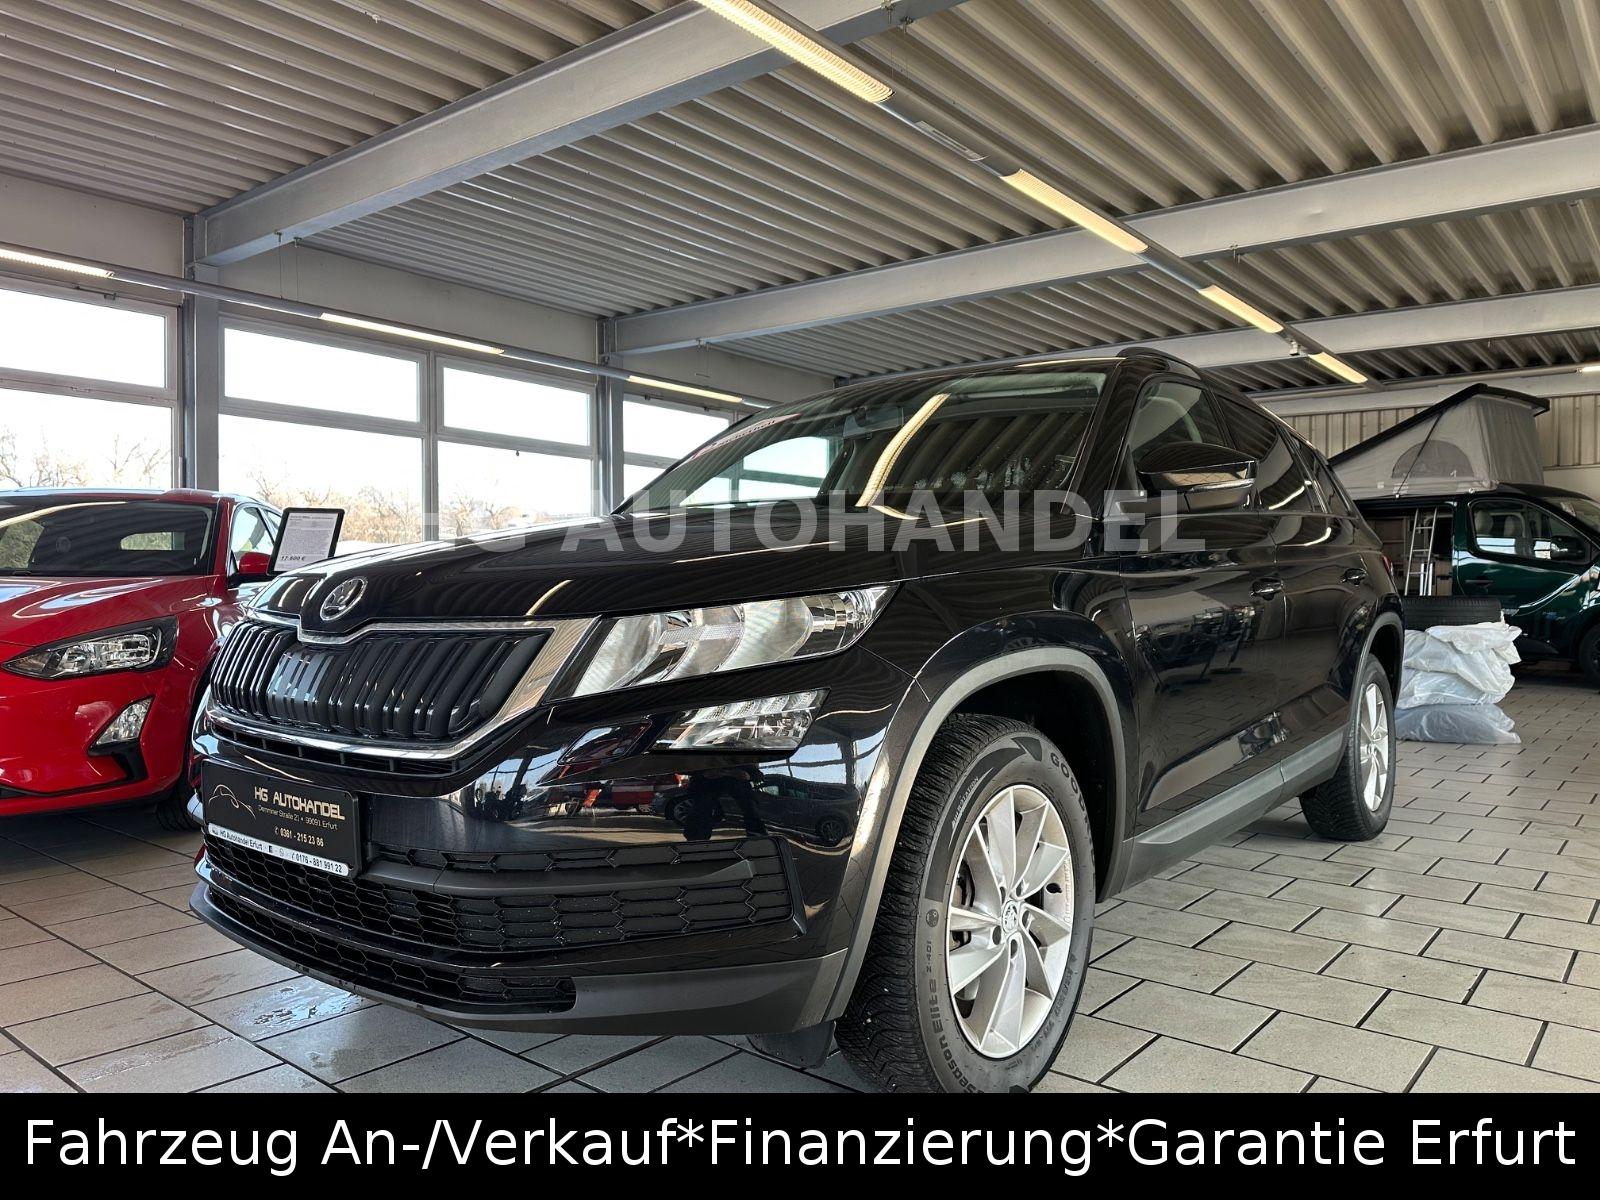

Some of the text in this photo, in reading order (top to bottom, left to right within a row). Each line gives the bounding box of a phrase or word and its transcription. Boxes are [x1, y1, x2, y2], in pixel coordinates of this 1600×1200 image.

[254, 786, 345, 821] HG AUTOHANDEL
[322, 818, 338, 830] Erfurt
[250, 839, 263, 851] Erfurt
[280, 827, 292, 839] 0361
[296, 832, 307, 843] 215
[308, 835, 316, 845] 23
[316, 837, 324, 847] 86
[295, 853, 308, 864] 0176
[323, 860, 334, 871] 991
[334, 863, 343, 873] 22
